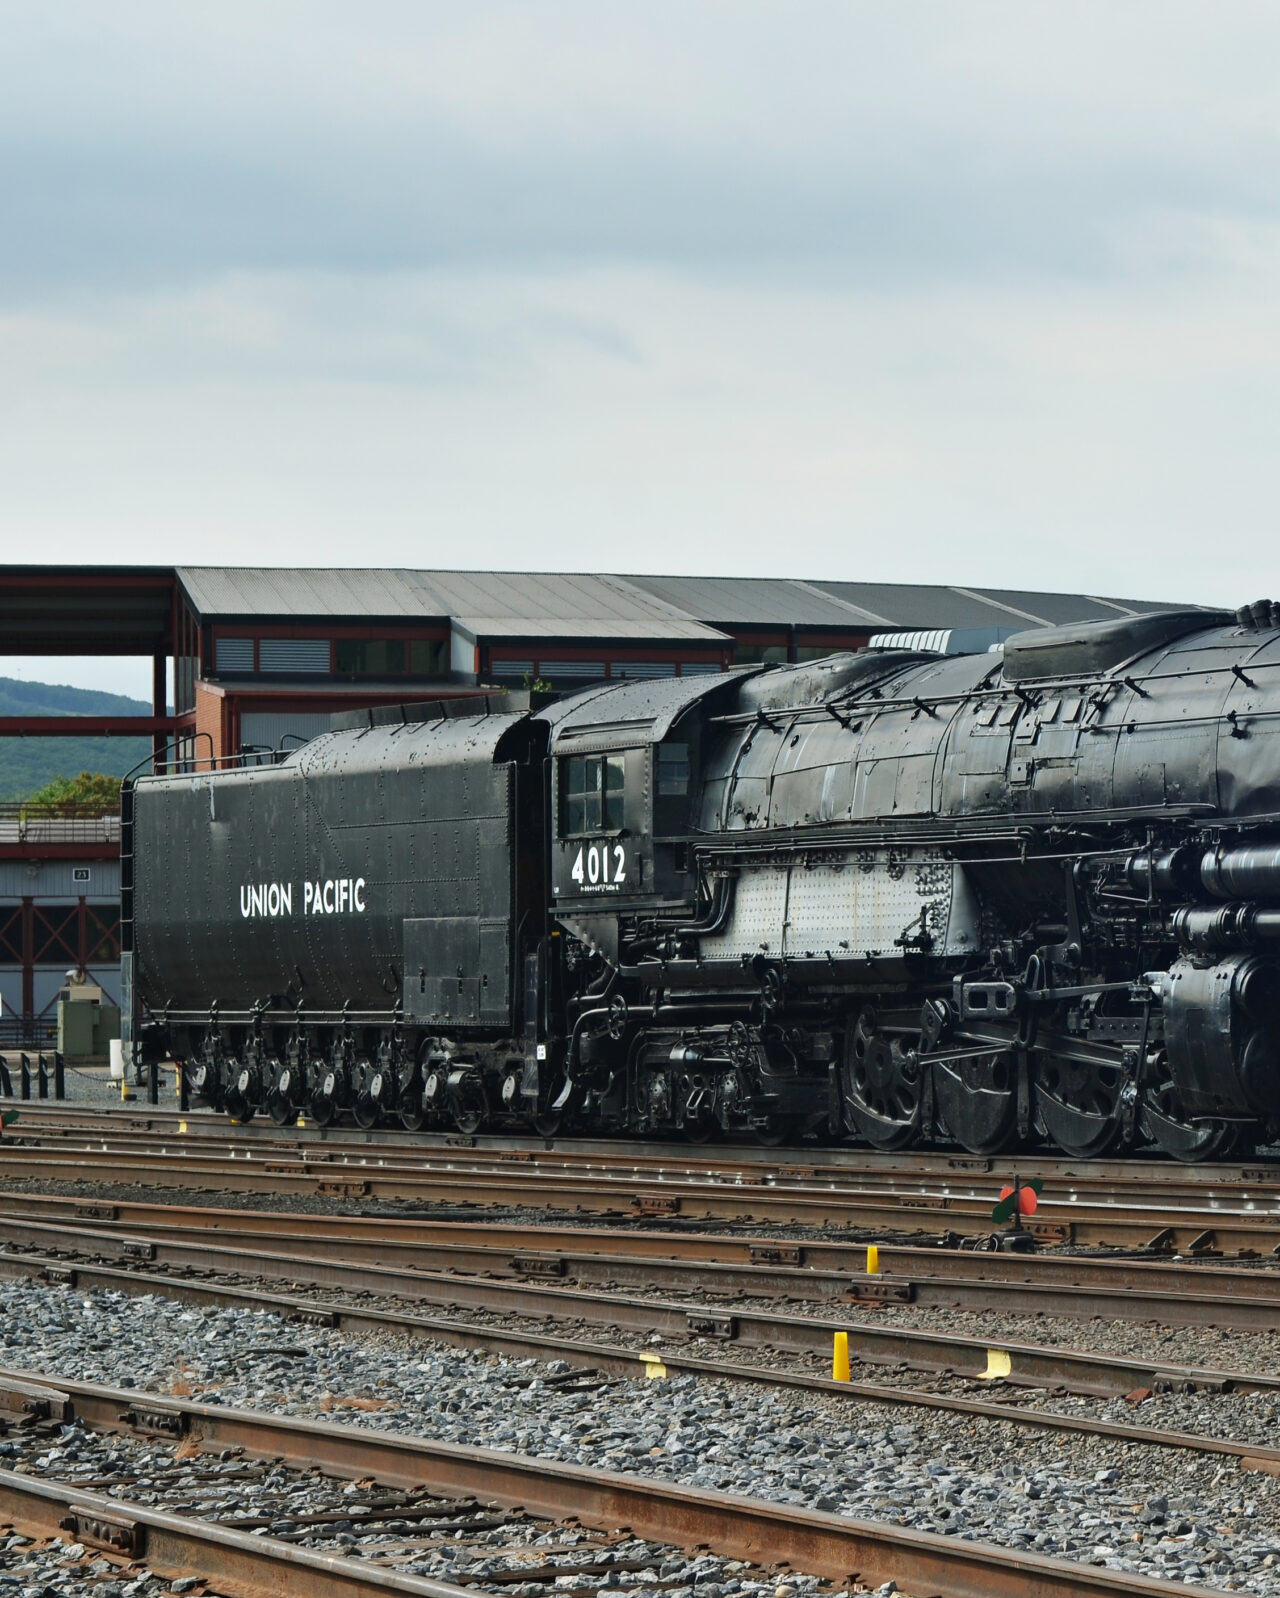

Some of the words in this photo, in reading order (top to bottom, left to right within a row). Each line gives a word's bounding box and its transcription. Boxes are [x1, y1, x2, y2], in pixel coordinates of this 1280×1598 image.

[571, 844, 626, 884] 4012
[240, 882, 292, 918] UNION
[304, 877, 366, 915] PACIFIC
